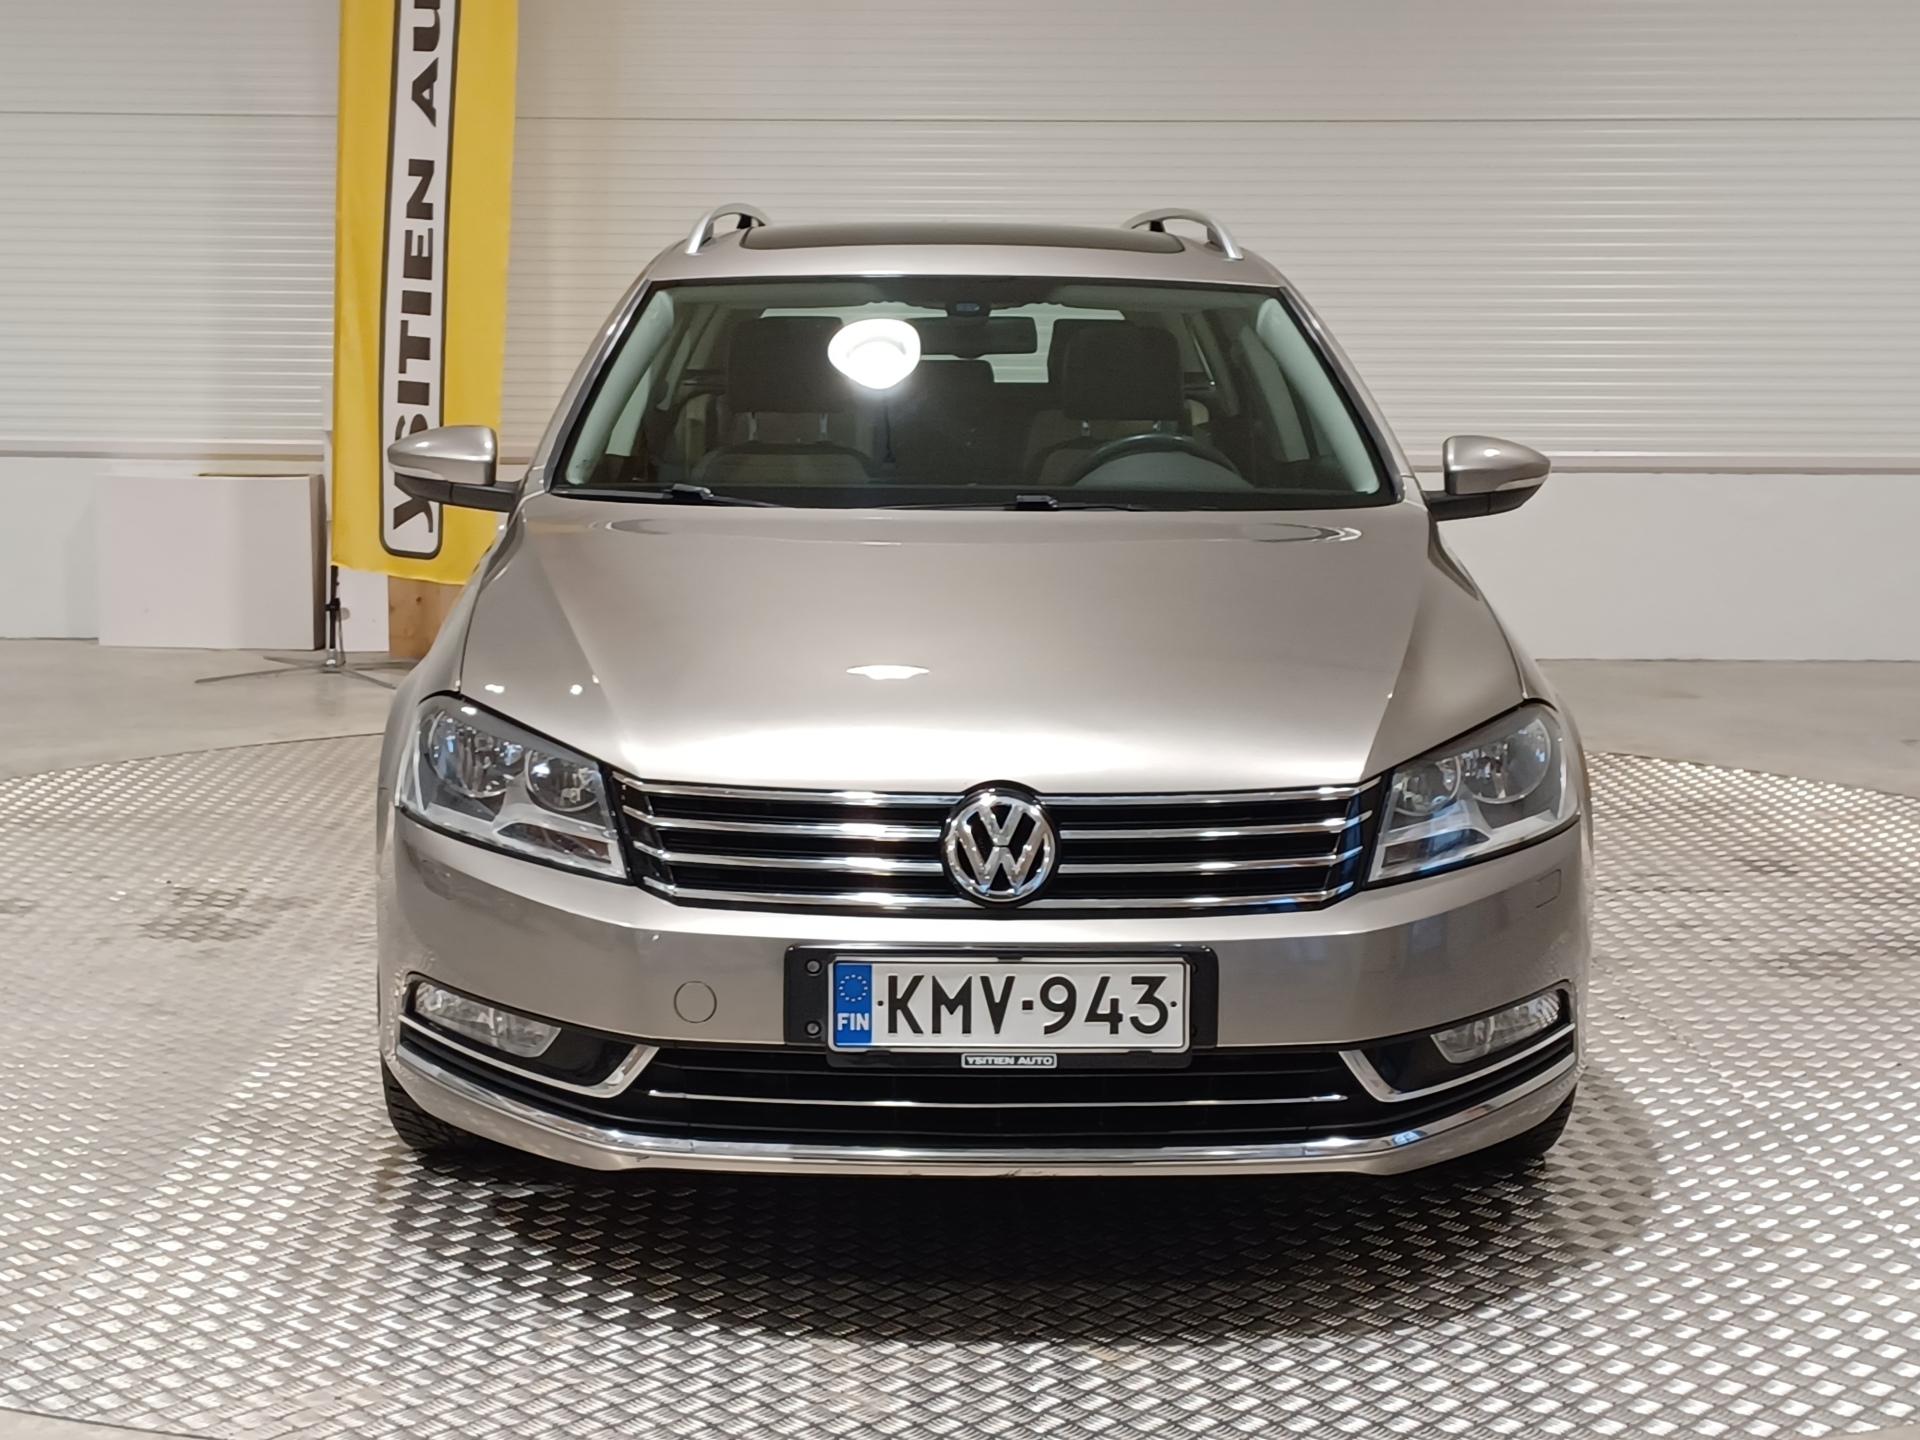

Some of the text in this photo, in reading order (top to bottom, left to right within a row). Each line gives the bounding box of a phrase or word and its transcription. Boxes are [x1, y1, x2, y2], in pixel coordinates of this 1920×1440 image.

[887, 975, 1169, 1035] KMV-943
[837, 1012, 870, 1031] FIN
[966, 1056, 1053, 1065] YSITIEN AUTO
